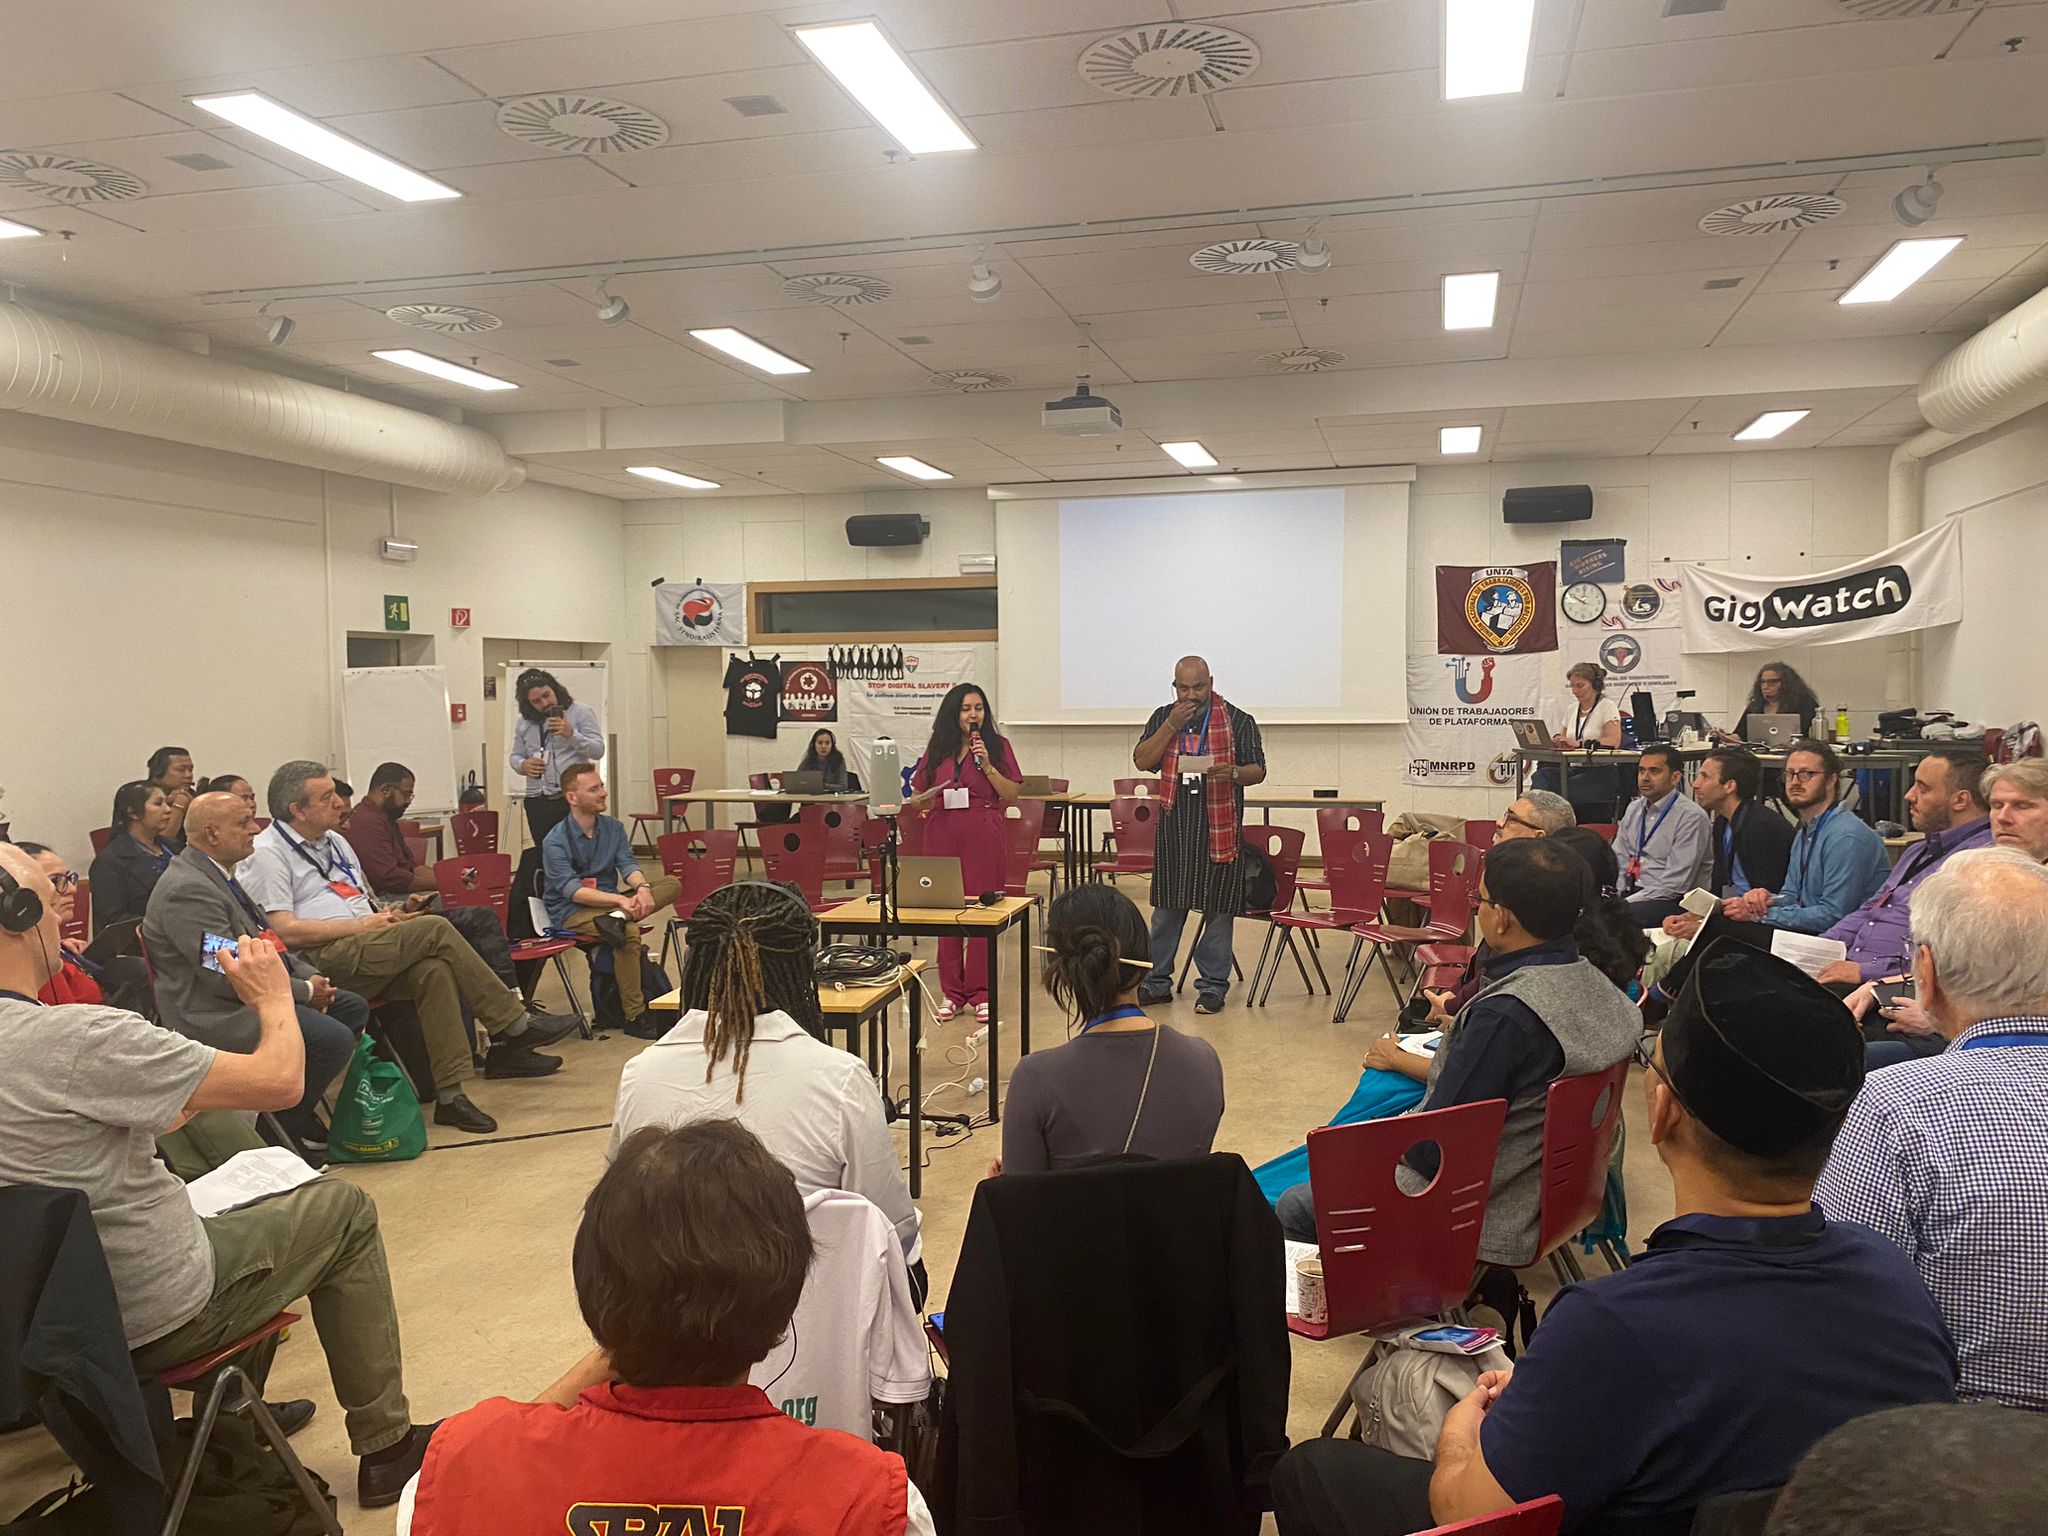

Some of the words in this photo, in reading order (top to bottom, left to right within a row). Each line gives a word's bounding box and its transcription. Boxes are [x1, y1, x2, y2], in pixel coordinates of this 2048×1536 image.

[1485, 568, 1514, 576] UNTA
[1704, 594, 1763, 629] Gig
[1409, 706, 1439, 716] UNIÓN
[1441, 707, 1455, 716] DE
[1456, 707, 1535, 716] TRABAJADORES
[1429, 718, 1442, 726] DE
[1430, 761, 1476, 771] MNRPD
